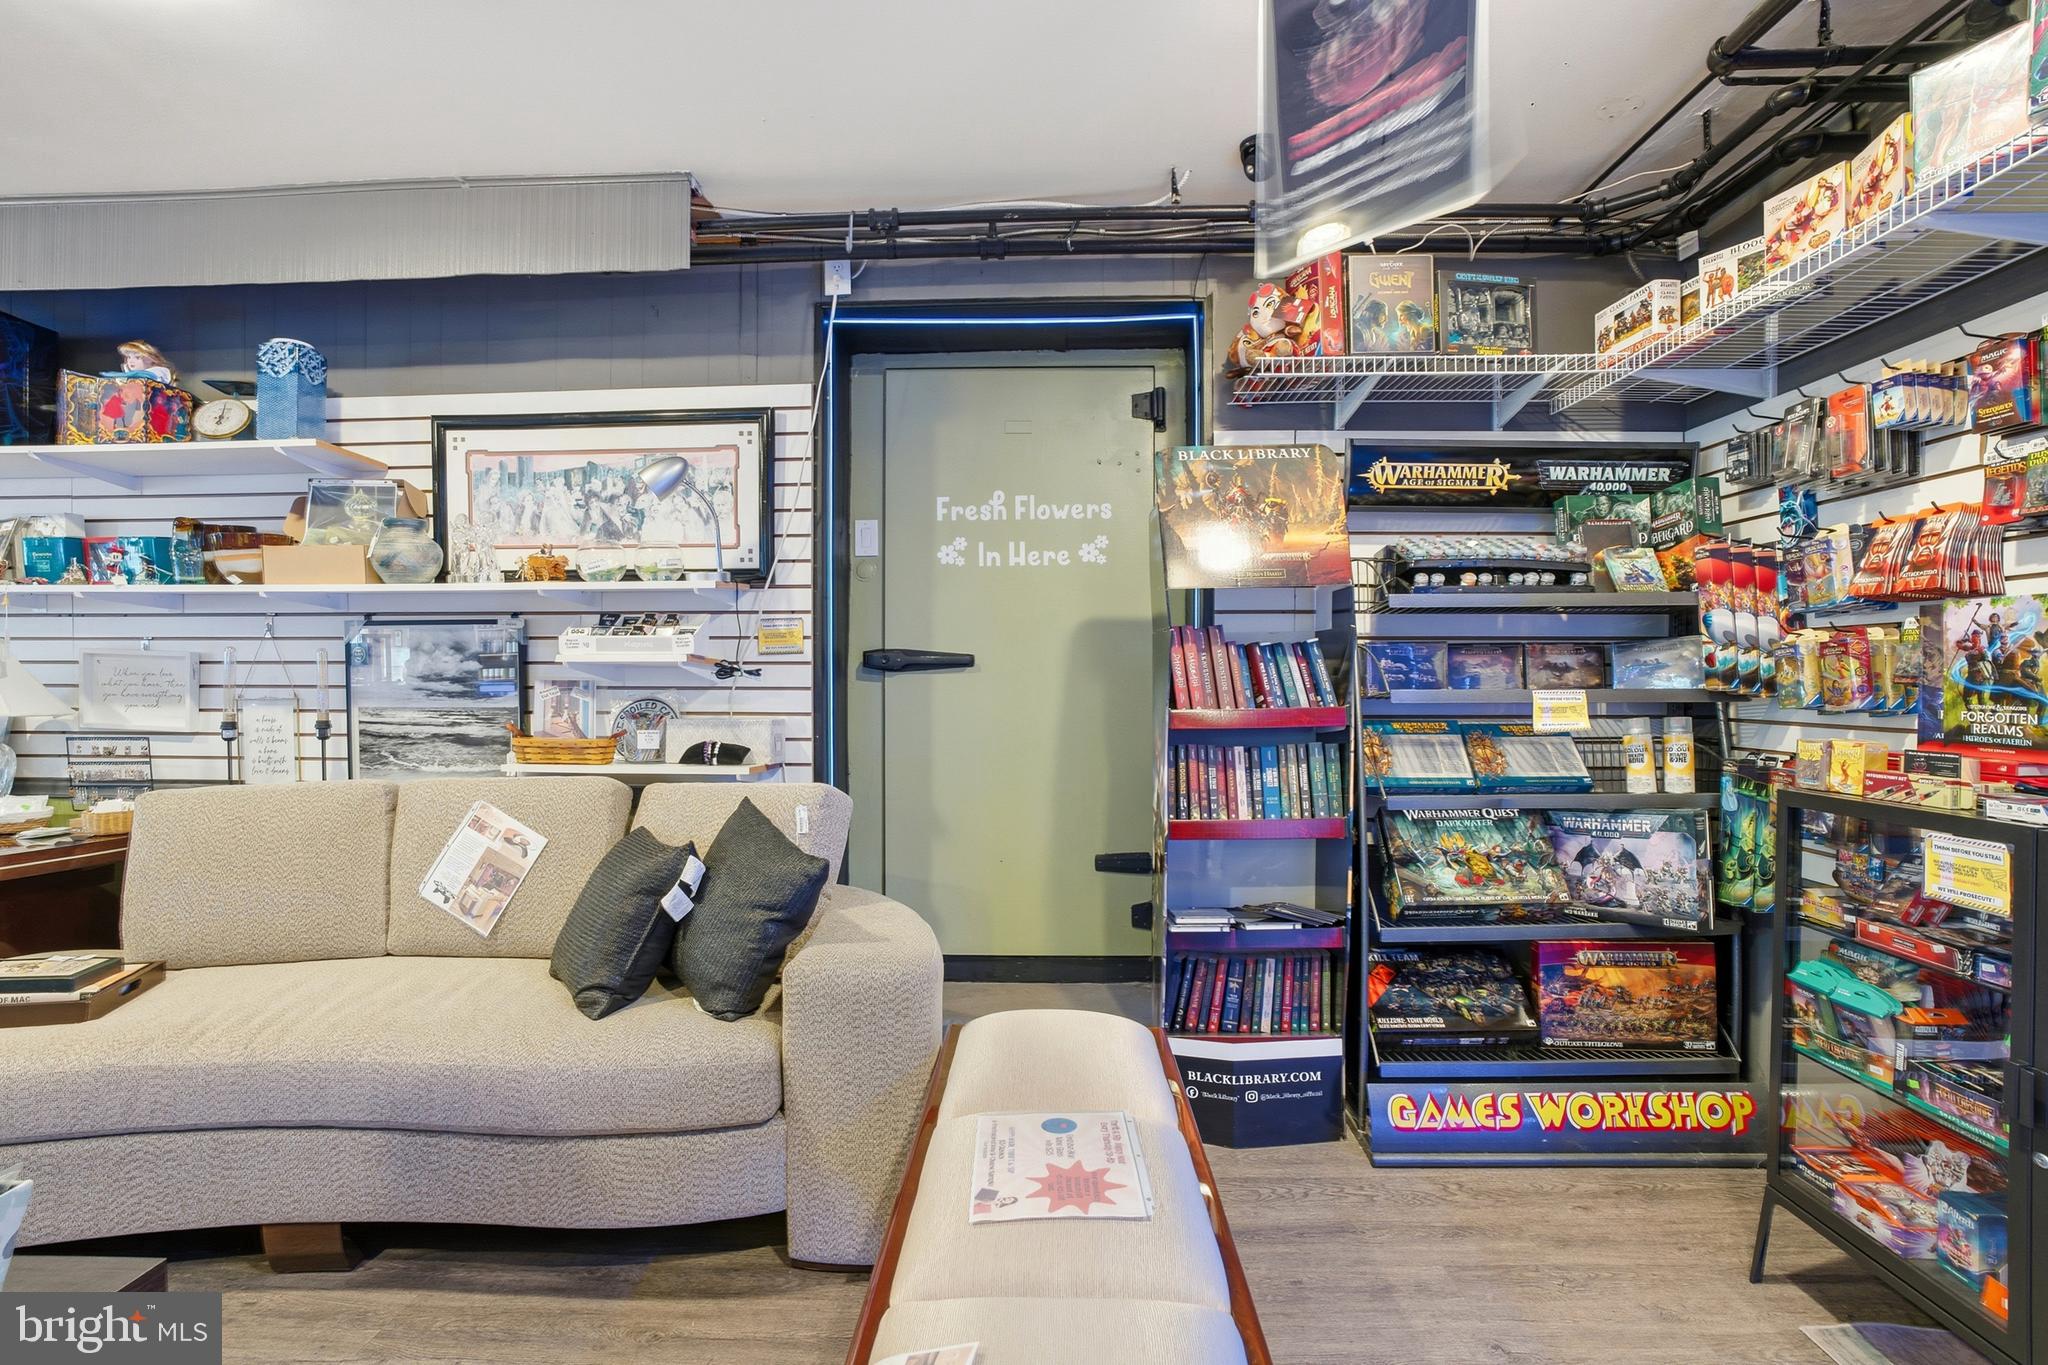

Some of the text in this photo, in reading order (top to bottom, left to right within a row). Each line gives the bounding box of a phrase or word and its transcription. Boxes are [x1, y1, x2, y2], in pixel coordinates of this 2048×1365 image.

[1369, 272, 1415, 289] GWENT
[1981, 348, 2008, 361] MAGIC
[1177, 447, 1312, 461] BLACK LIBRARY
[1375, 464, 1503, 486] WARHAMMER
[1549, 466, 1671, 482] WARHAMMER
[1985, 461, 2028, 478] LEGENDS
[1589, 482, 1627, 492] 40,000
[936, 489, 1112, 521] Fresh Flowers
[978, 540, 1071, 567] In Here
[1961, 711, 2038, 725] FORGOTTEN
[1972, 724, 2024, 737] REALMS
[1964, 735, 1993, 743] HEROES
[1403, 807, 1520, 821] WARHAMMER QUEST
[1436, 819, 1494, 827] DARKWATER
[1563, 817, 1651, 833] WARHAMMER
[1951, 847, 1971, 855] BEFORE
[1960, 892, 1991, 903] PROSECUTE
[1368, 952, 1420, 962] KILL TEAM
[1187, 1070, 1322, 1085] BLACKLIBRARY.COM
[1388, 1090, 1757, 1135] GAMES WORKSHOP
